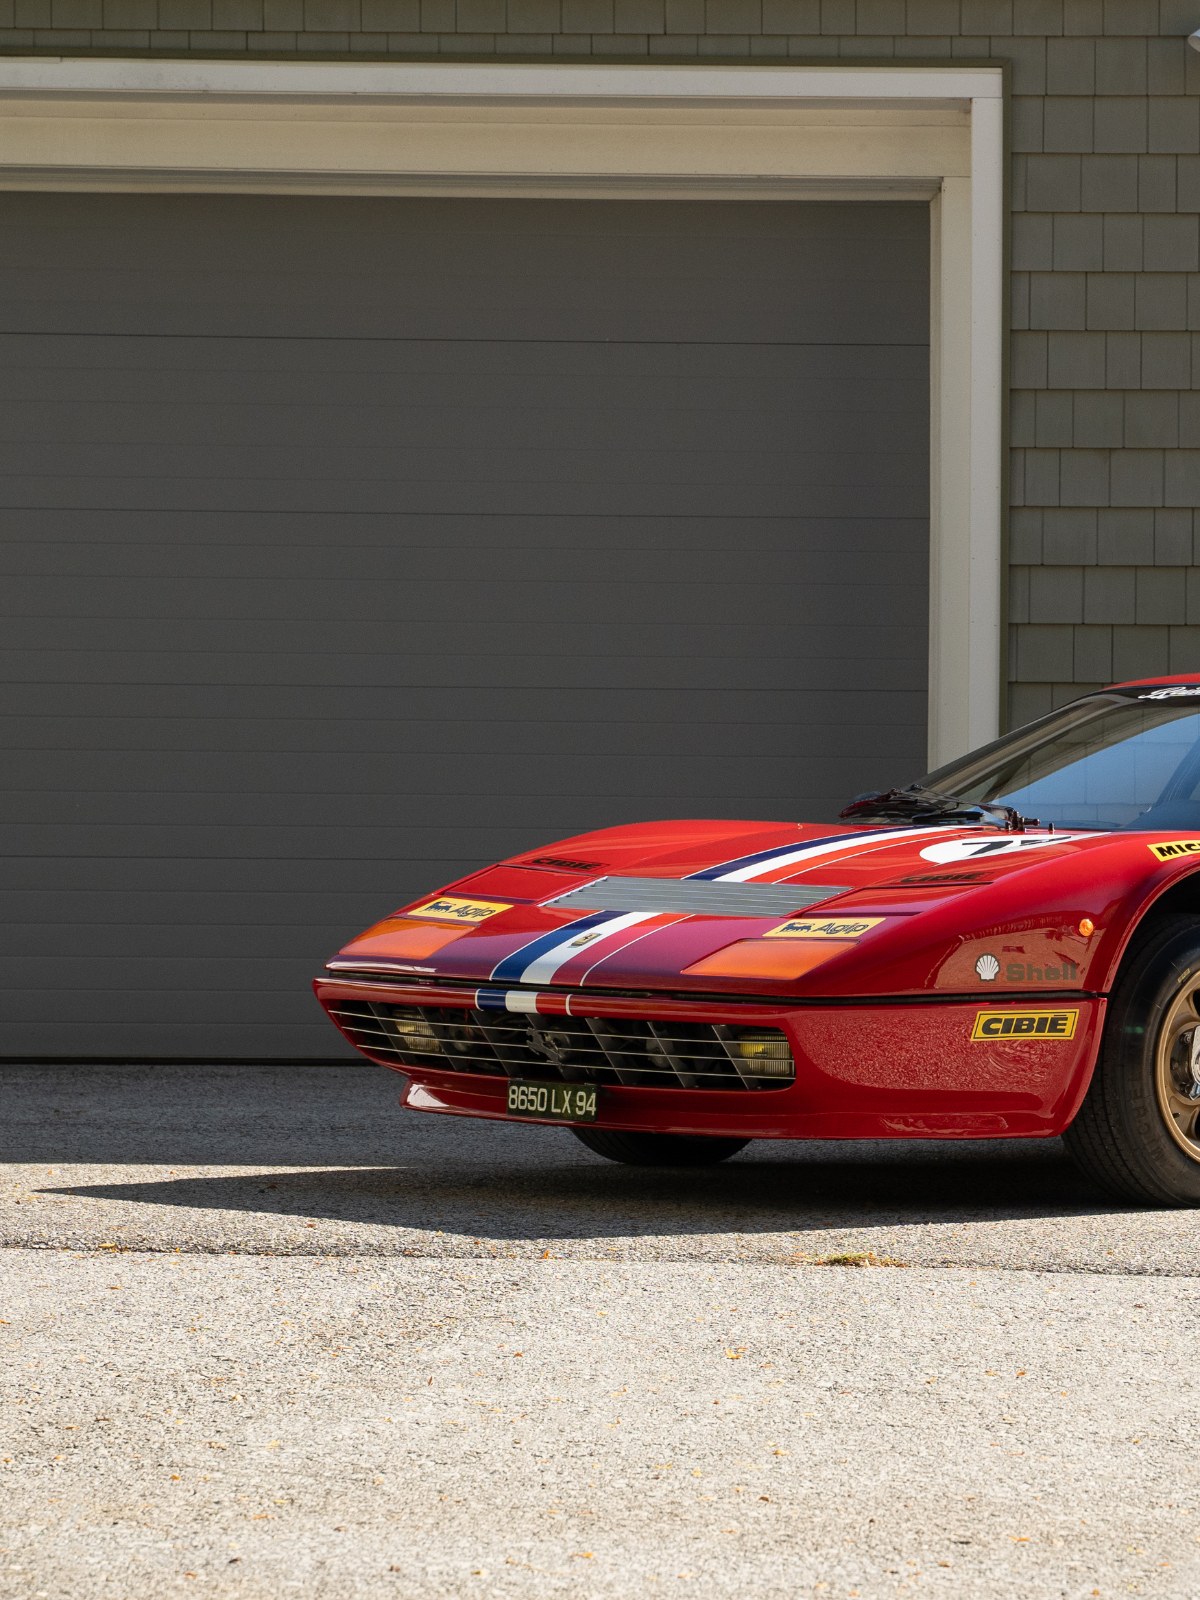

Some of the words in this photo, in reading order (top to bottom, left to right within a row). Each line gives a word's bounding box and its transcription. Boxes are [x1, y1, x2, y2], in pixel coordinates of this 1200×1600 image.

[452, 903, 496, 919] Agip
[812, 922, 870, 935] Agip
[1006, 962, 1077, 981] Shell
[508, 1085, 548, 1112] 8650
[551, 1089, 572, 1114] LX
[575, 1091, 597, 1116] 94
